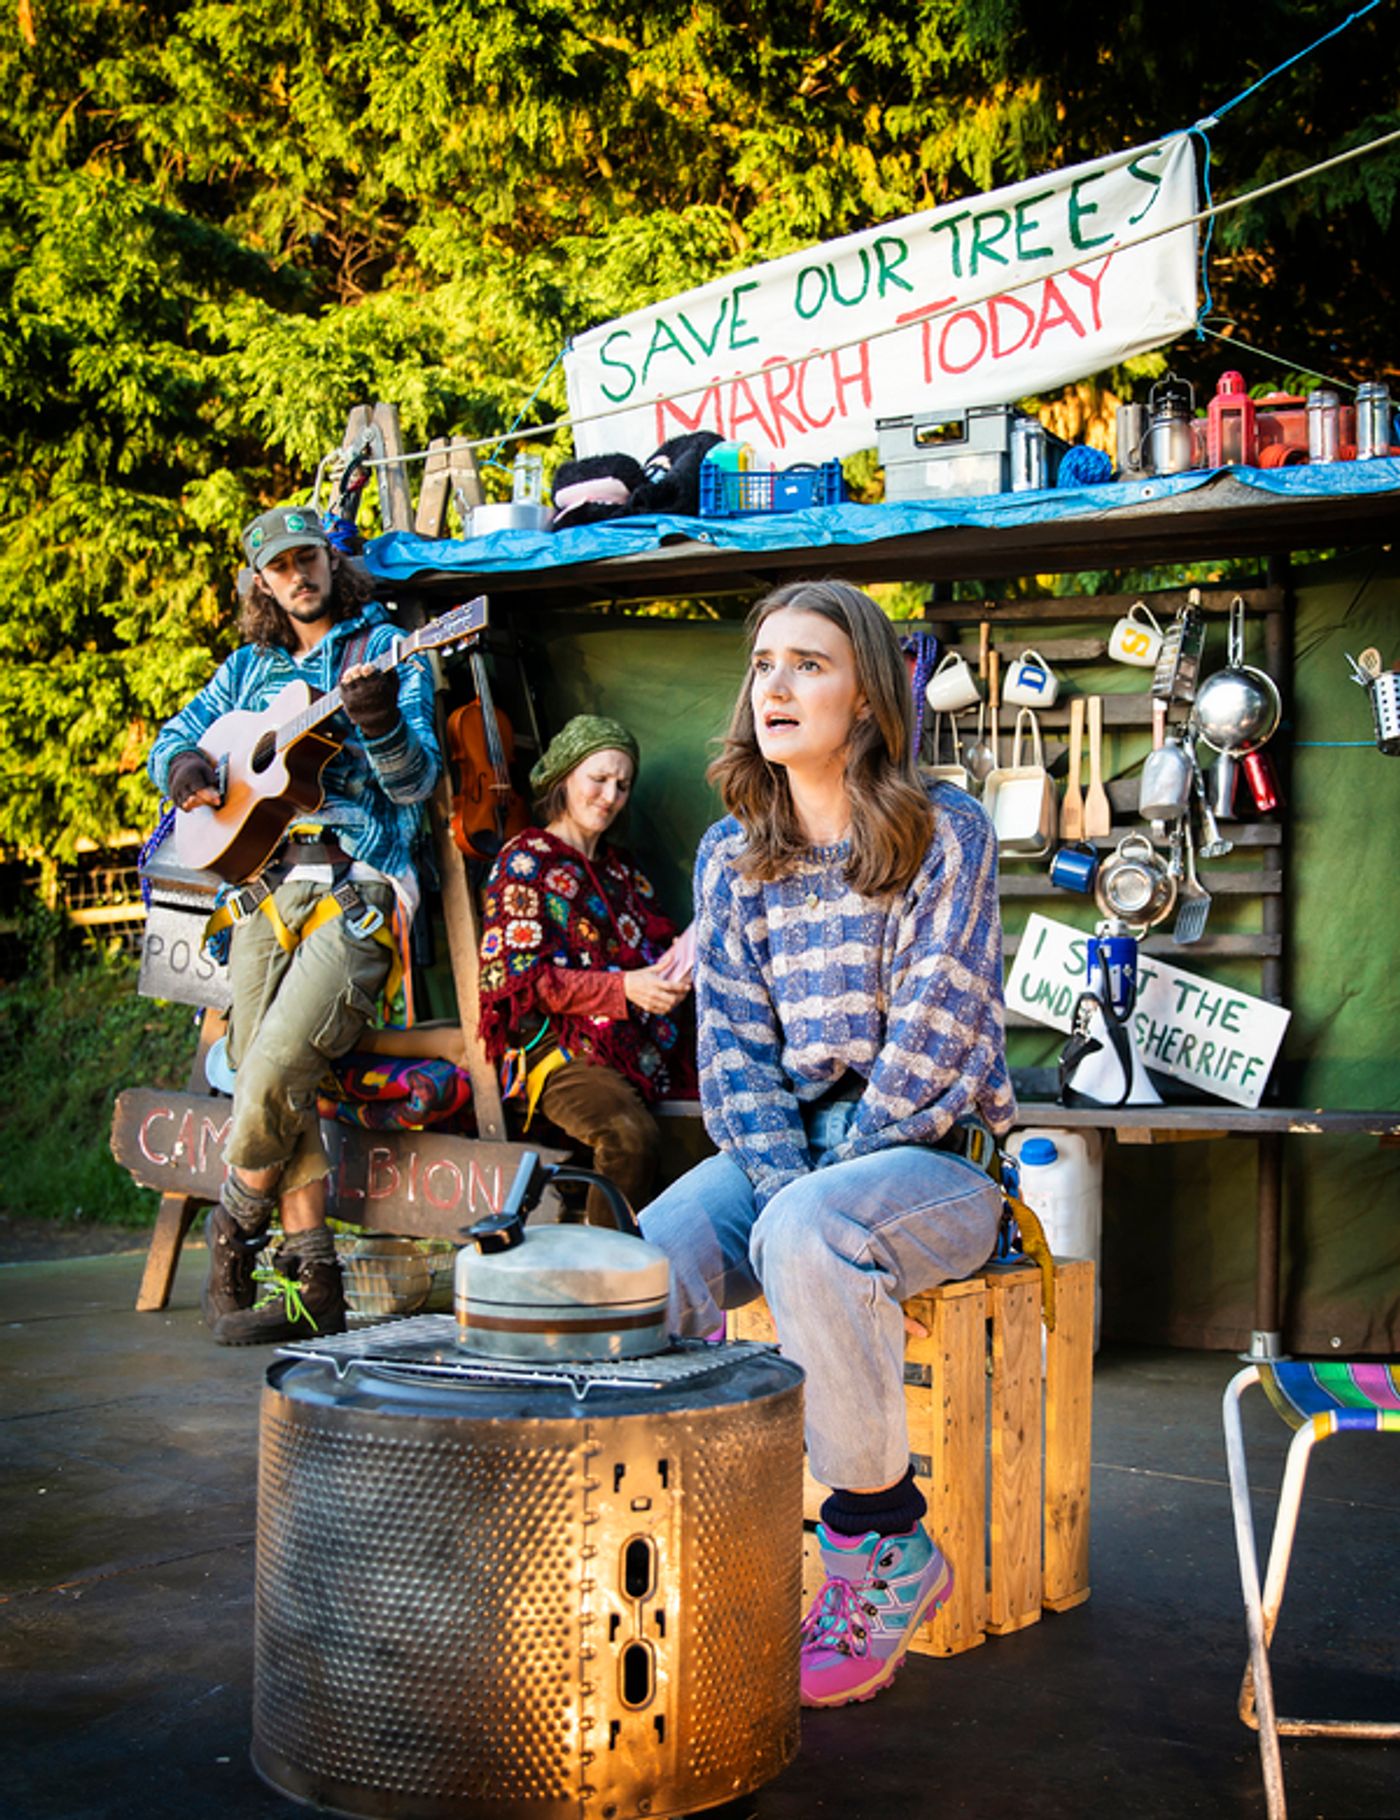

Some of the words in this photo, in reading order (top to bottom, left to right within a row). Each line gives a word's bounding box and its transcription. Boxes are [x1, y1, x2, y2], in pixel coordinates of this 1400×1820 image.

[599, 280, 760, 403] SAVE
[794, 236, 914, 320] OUR
[929, 149, 1162, 279] TREES
[655, 339, 873, 449] MARCH
[895, 240, 1120, 384] TODAY
[1016, 665, 1048, 694] D
[1120, 627, 1151, 657] S
[1033, 927, 1047, 960] I
[1063, 939, 1158, 998] ST
[1172, 979, 1248, 1034] THE
[1134, 1012, 1265, 1086] SHERRIFF
[138, 1106, 236, 1182] CAM
